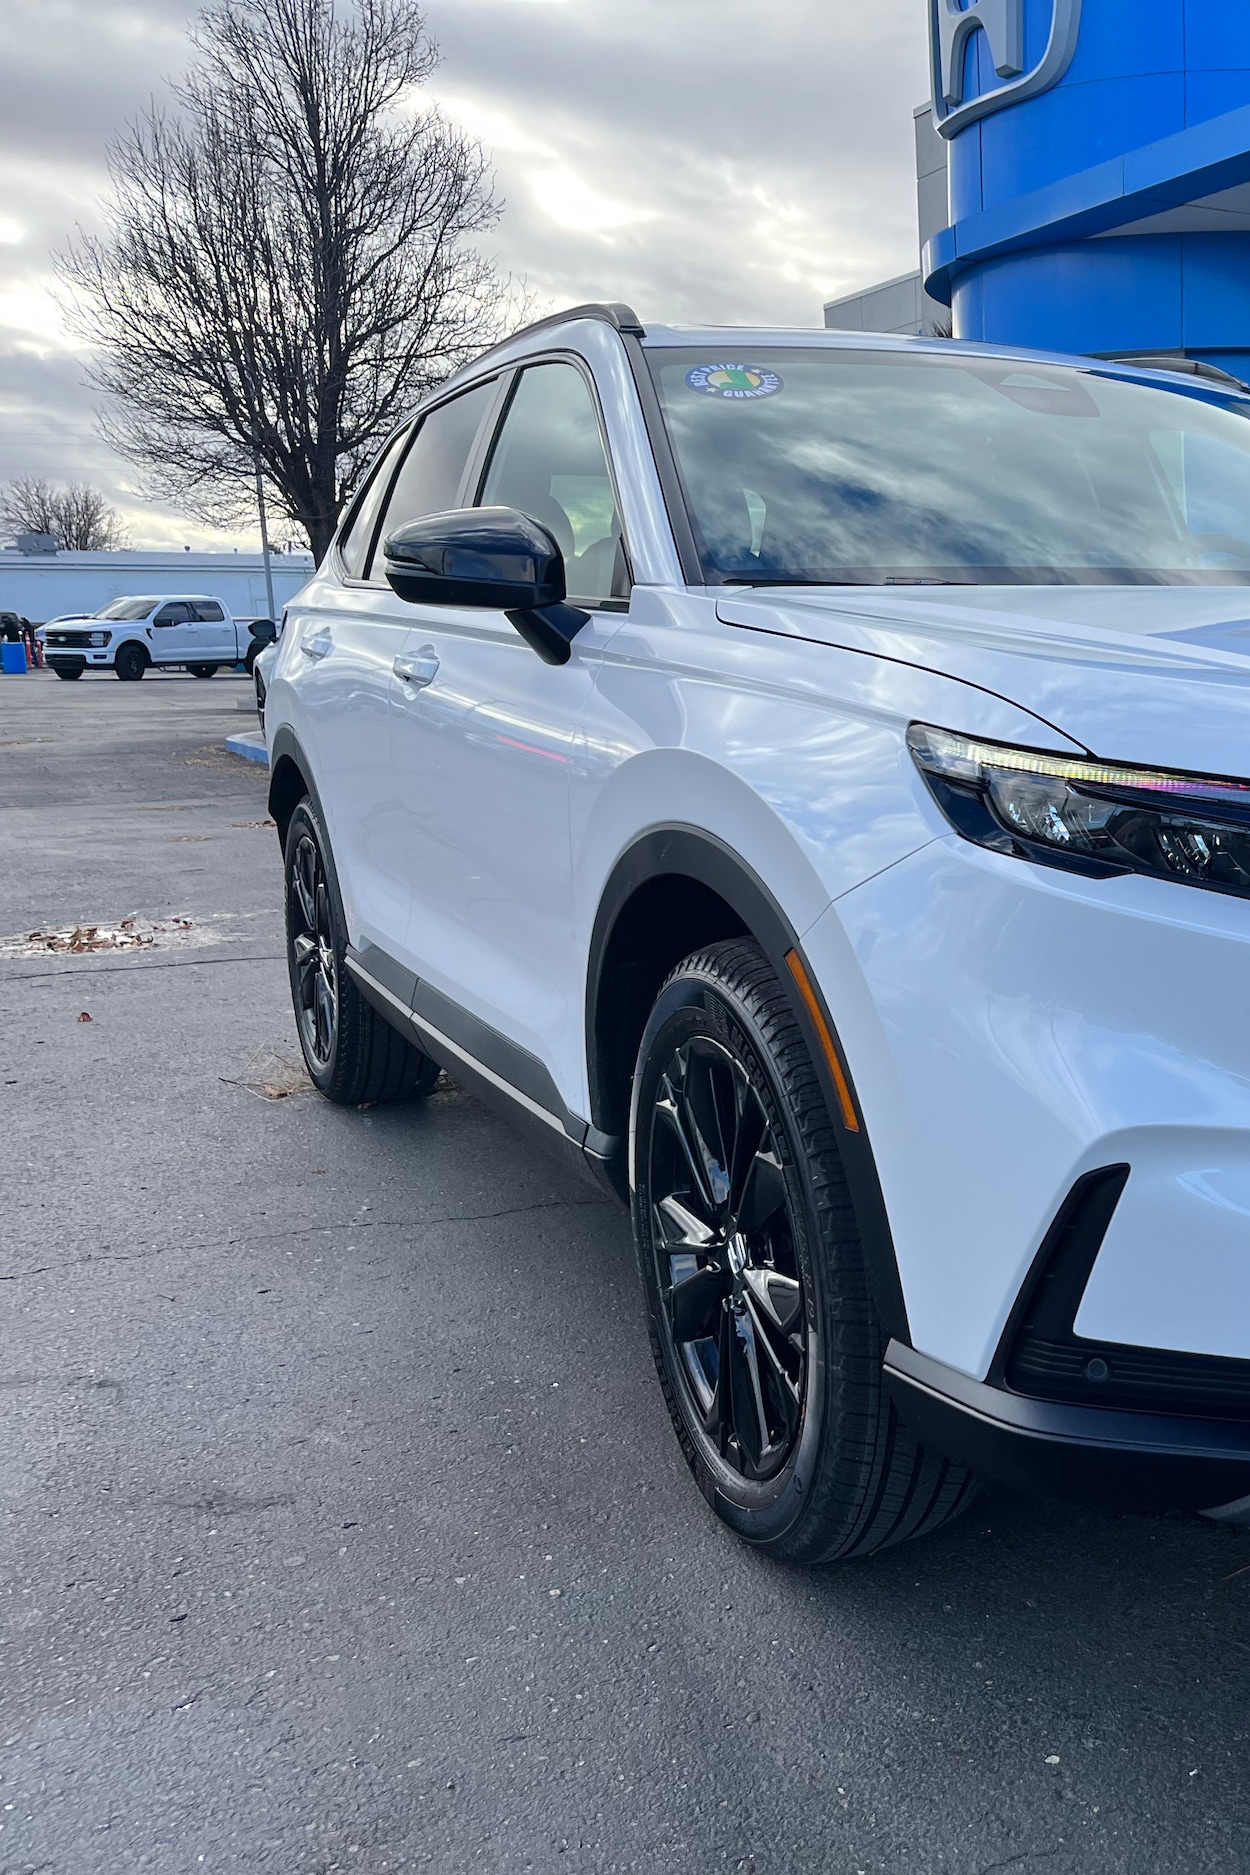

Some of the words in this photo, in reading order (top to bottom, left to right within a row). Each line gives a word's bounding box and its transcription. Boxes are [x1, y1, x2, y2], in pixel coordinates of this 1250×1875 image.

[690, 370, 709, 387] BEST
[700, 363, 745, 373] PRICE
[730, 1025, 794, 1167] MICHELIN
